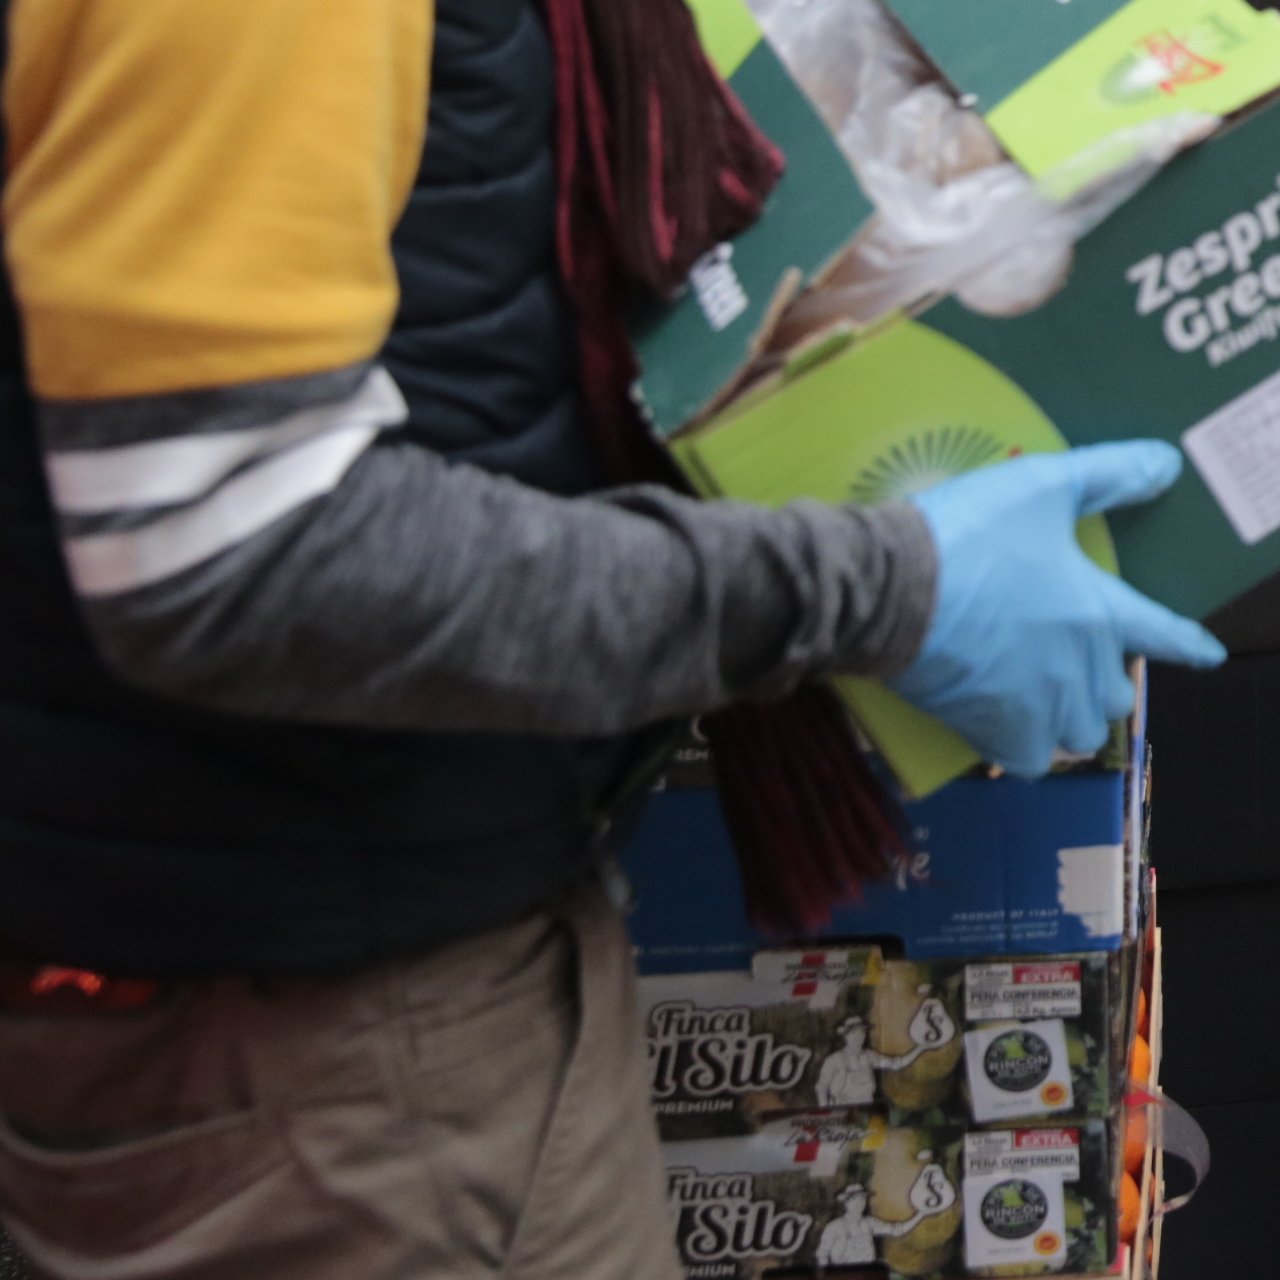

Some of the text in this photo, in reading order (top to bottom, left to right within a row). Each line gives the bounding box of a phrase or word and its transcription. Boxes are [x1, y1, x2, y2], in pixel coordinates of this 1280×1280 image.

[1020, 970, 1074, 983] EXTRA
[970, 987, 1078, 1002] PERA CONFERENCIA
[654, 1001, 748, 1037] Finca
[684, 1035, 810, 1097] Silo
[1021, 1133, 1073, 1146] EXTRA
[970, 1154, 1077, 1170] PERA CONFERENCIA
[666, 1170, 752, 1200] Finca
[687, 1201, 812, 1259] Silo
[685, 1263, 735, 1278] MIUM
